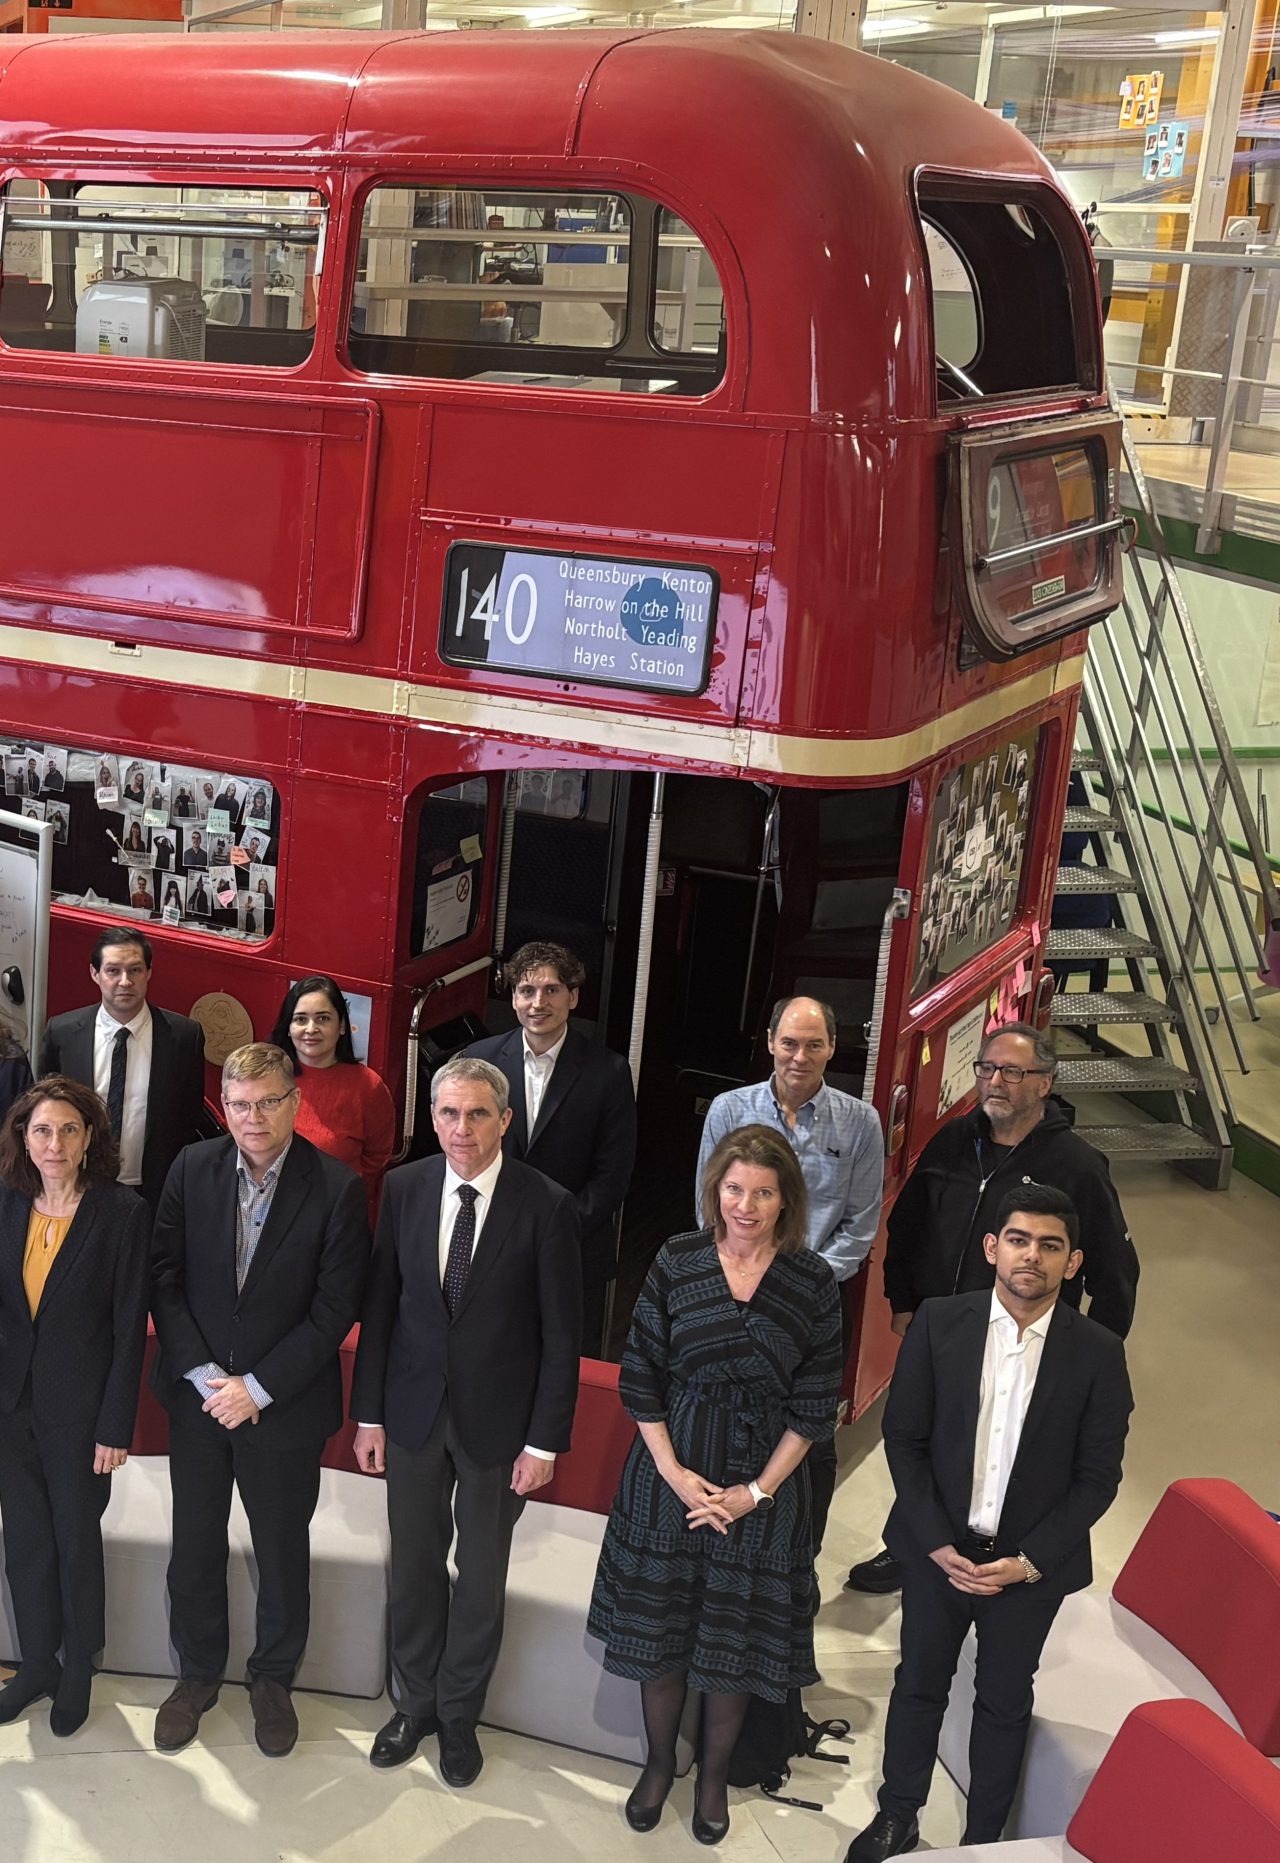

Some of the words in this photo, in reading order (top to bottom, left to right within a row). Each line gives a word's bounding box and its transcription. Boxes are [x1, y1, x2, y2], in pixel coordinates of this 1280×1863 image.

[559, 561, 646, 592] Queensbury
[455, 567, 538, 645] 140
[564, 590, 616, 612] Harrow
[621, 601, 638, 615] on
[644, 599, 669, 618] the
[675, 601, 705, 622] Hill
[564, 617, 628, 641] Northolt
[641, 625, 697, 653] Yeading
[574, 648, 616, 670] Hayes
[630, 652, 685, 677] Station
